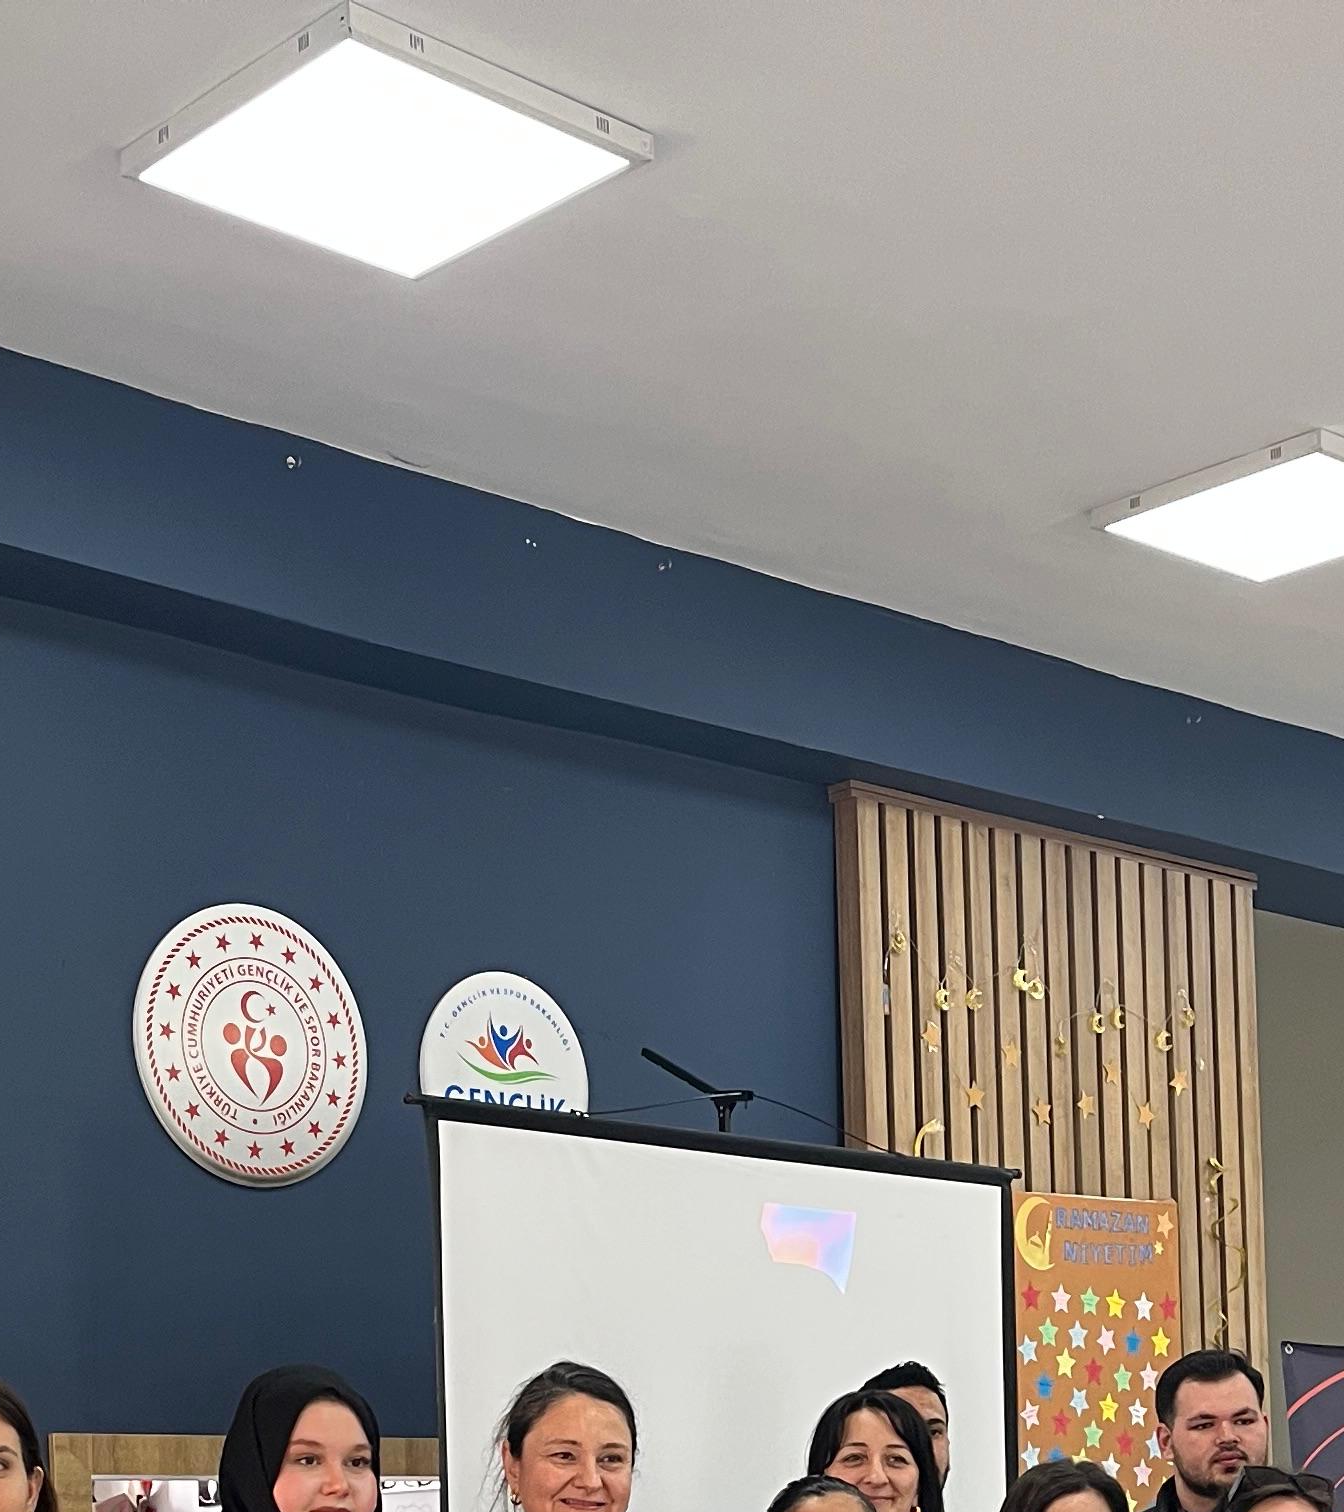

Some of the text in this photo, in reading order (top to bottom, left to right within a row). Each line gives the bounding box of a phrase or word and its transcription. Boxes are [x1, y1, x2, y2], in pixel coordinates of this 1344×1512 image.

[237, 964, 294, 995] GENÇLİK
[187, 963, 235, 1059] CUMHURİYETİ
[294, 992, 309, 1014] VE
[304, 1015, 322, 1058] SPOR
[272, 1062, 321, 1127] BAKANLIĞI
[1055, 1205, 1150, 1235] RAMAZAN
